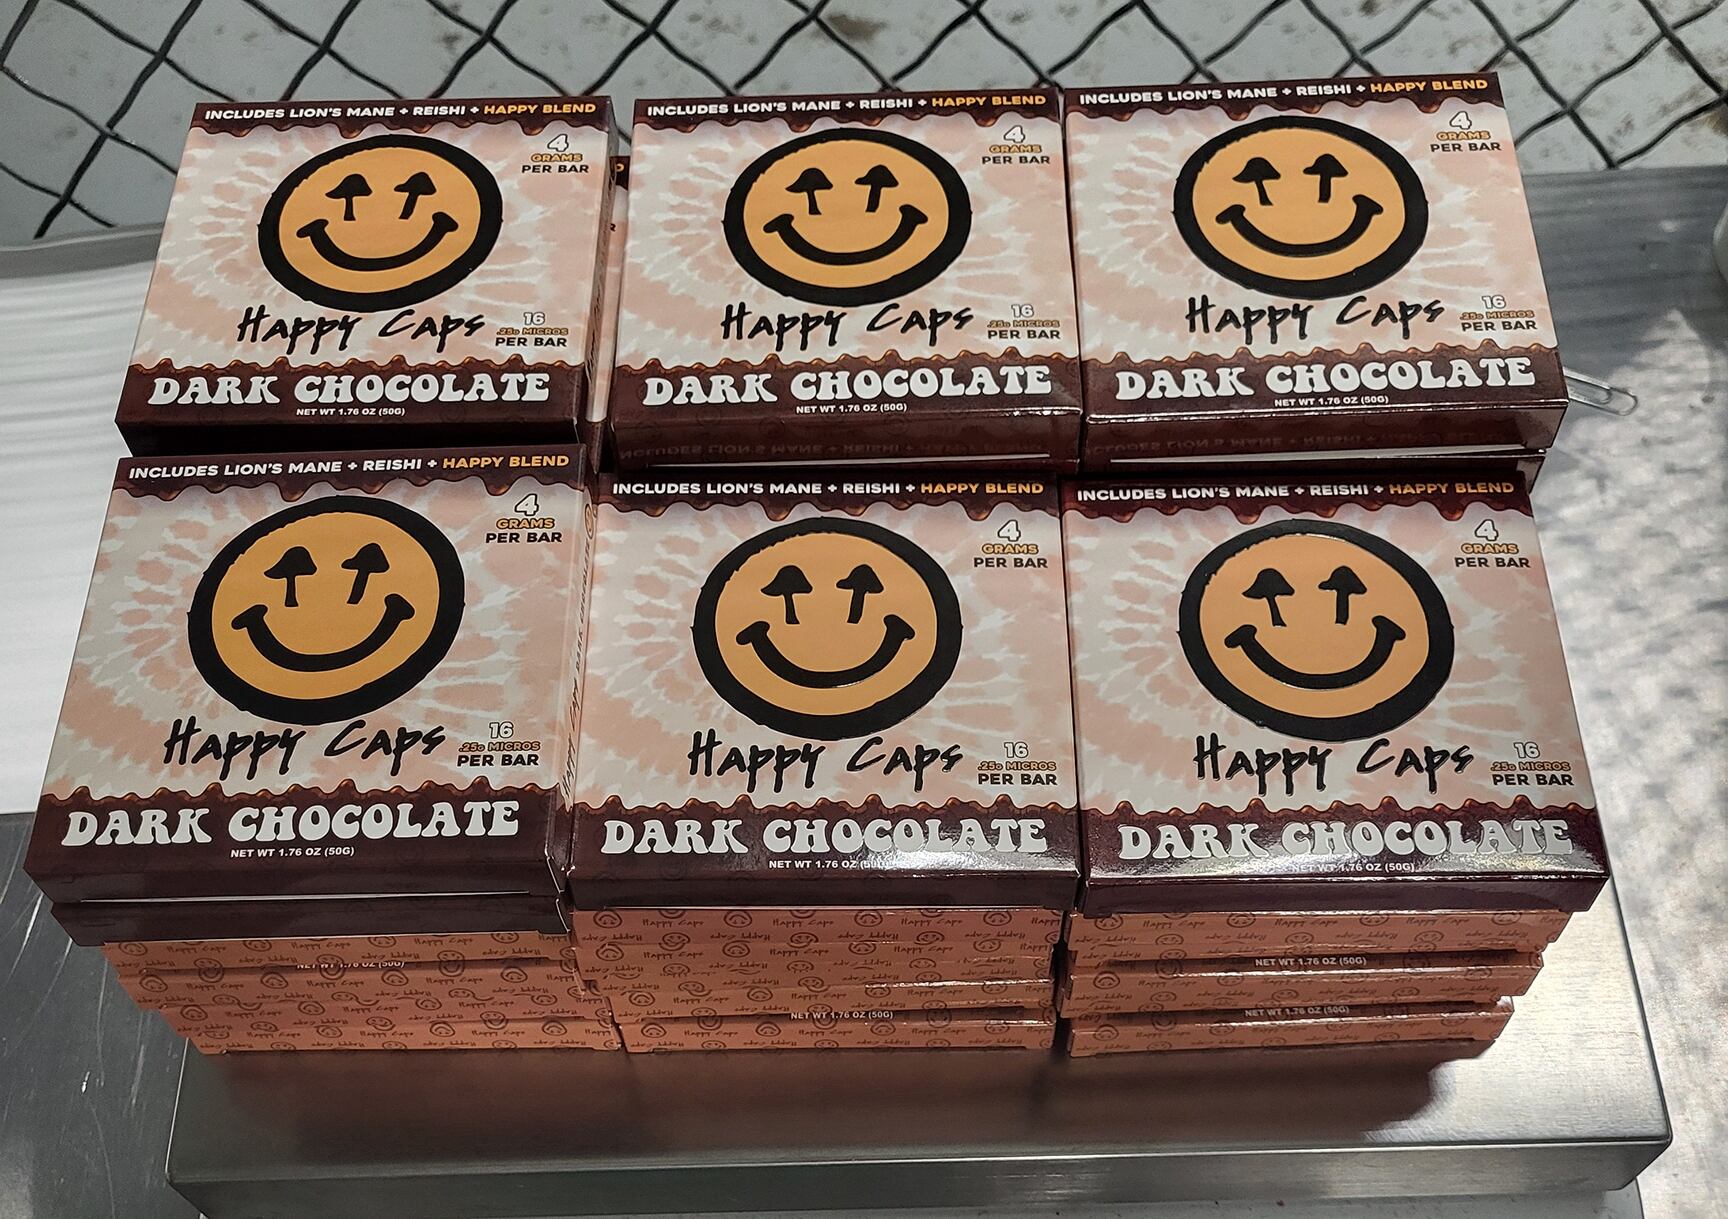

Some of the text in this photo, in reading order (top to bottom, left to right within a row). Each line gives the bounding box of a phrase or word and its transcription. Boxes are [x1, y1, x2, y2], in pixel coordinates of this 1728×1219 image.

[1080, 80, 1487, 103] INCLUDES LION'S MANE REISHI HAPPY BLEND
[205, 104, 595, 118] INCLUDES LION'S MANE REISHI HAPPY BLEND
[647, 94, 1045, 115] INCLUDES LION'S MANE REISHI HAPPY BLEND
[1448, 111, 1472, 130] 4
[1003, 124, 1025, 143] 4
[1435, 130, 1491, 141] GRAMS
[546, 134, 569, 152] 4
[988, 143, 1042, 153] GRAMS
[1429, 142, 1502, 152] PER BAR
[530, 153, 583, 162] GRAMS
[981, 155, 1050, 164] PER BAR
[521, 164, 589, 173] PER BAR
[1481, 294, 1506, 308] 16
[1010, 303, 1033, 317] 16
[523, 311, 545, 325] 16
[1184, 293, 1444, 345] Happy Caps
[236, 304, 485, 355] Happy Caps
[720, 301, 973, 352] Happy Caps
[1461, 320, 1537, 331] PER BAR
[987, 328, 1060, 338] PER BAR
[495, 337, 566, 346] PER BAR
[641, 364, 1051, 404] DARK CHOCOLATE
[1115, 357, 1535, 399] DARK CHOCOLATE
[147, 373, 549, 404] DARK CHOCOLATE
[796, 405, 817, 413] NET
[820, 404, 836, 412] WT
[863, 403, 878, 411] OZ
[128, 455, 568, 478] INCLUDES LION'S MANE REISHI HAPPY BLEND
[613, 482, 1043, 494] INCLUDES LION'S MANE REISHI HAPPY BLEND
[1078, 482, 1514, 500] INCLUDES LION'S MANE REISHI HAPPY BLEND
[514, 493, 539, 516] 4
[495, 517, 555, 529] GRAMS
[1473, 519, 1499, 541] 4
[485, 532, 561, 543] PER BAR
[997, 519, 1021, 542] 4
[981, 542, 1039, 554] GRAMS
[1460, 542, 1519, 554] GRAMS
[973, 557, 1048, 568] PER BAR
[1453, 557, 1531, 567] PER BAR
[488, 721, 513, 738] 16
[163, 715, 445, 780] Happy Caps
[487, 740, 540, 751] MICROS
[1003, 741, 1028, 758] 16
[1513, 741, 1540, 758] 16
[457, 753, 538, 766] PER BAR
[687, 728, 962, 793] Happy Caps
[1005, 760, 1056, 771] MICROS
[1192, 732, 1473, 796] Happy Caps
[1518, 761, 1571, 771] MICROS
[978, 773, 1057, 785] PER BAR
[1491, 773, 1574, 785] PER BAR
[60, 800, 519, 846] DARK CHOCOLATE
[600, 818, 1046, 853] DARK CHOCOLATE
[1118, 819, 1573, 859] DARK CHOCOLATE
[230, 846, 354, 857] NET WT 1.76 OZ (50G)
[769, 860, 791, 868] NET
[794, 860, 812, 868] WT
[842, 859, 857, 867] OZ
[1366, 862, 1383, 870] OZ
[1385, 862, 1415, 872] (50G)
[1255, 958, 1276, 966] NET
[1278, 958, 1295, 966] WT
[1322, 957, 1337, 965] OZ
[1339, 956, 1367, 966] (50G)
[868, 1011, 893, 1019] (50G)
